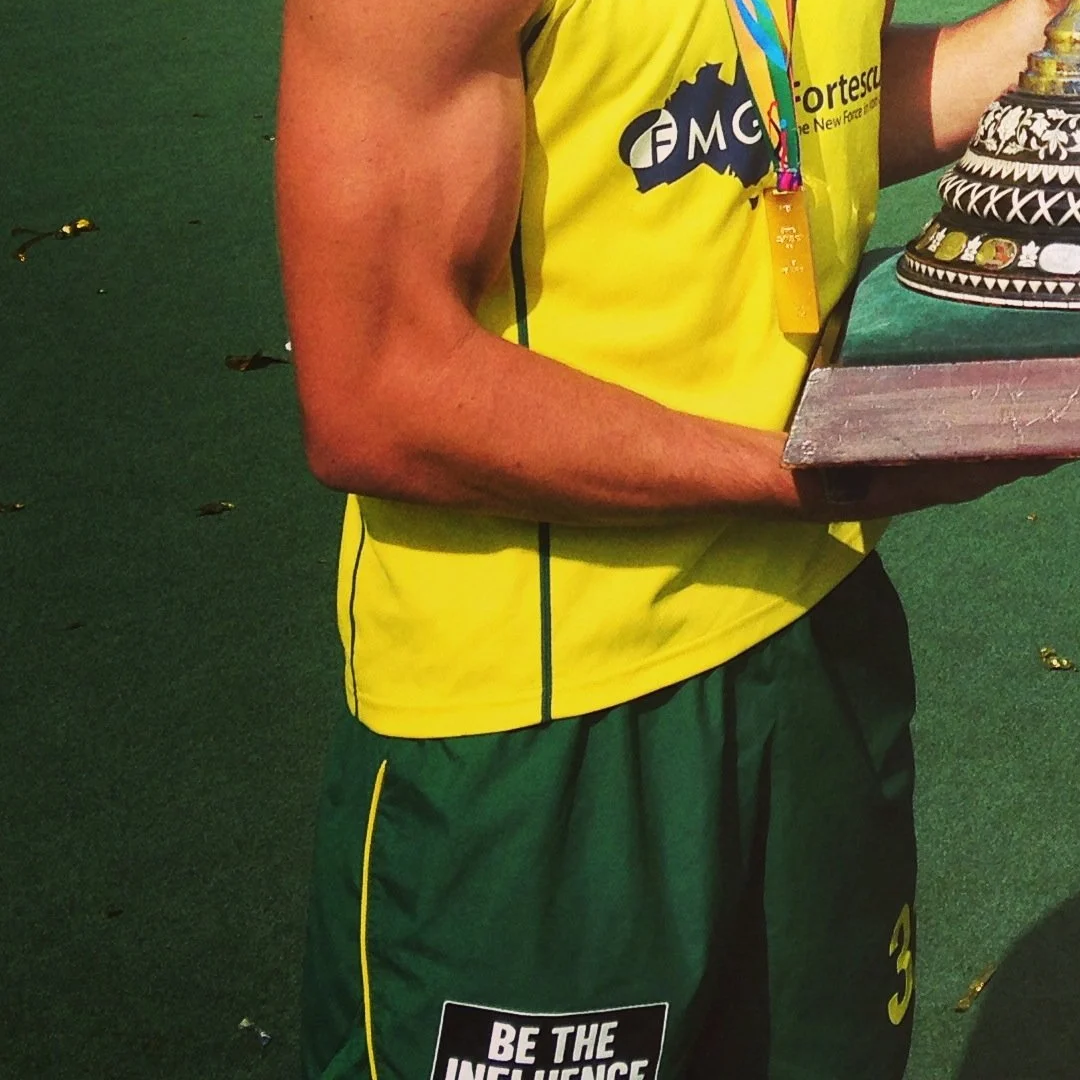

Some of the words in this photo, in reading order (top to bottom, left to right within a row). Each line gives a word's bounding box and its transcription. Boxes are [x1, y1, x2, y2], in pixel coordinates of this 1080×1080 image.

[814, 117, 841, 132] New
[488, 1021, 540, 1065] BE
[551, 1021, 618, 1064] THE
